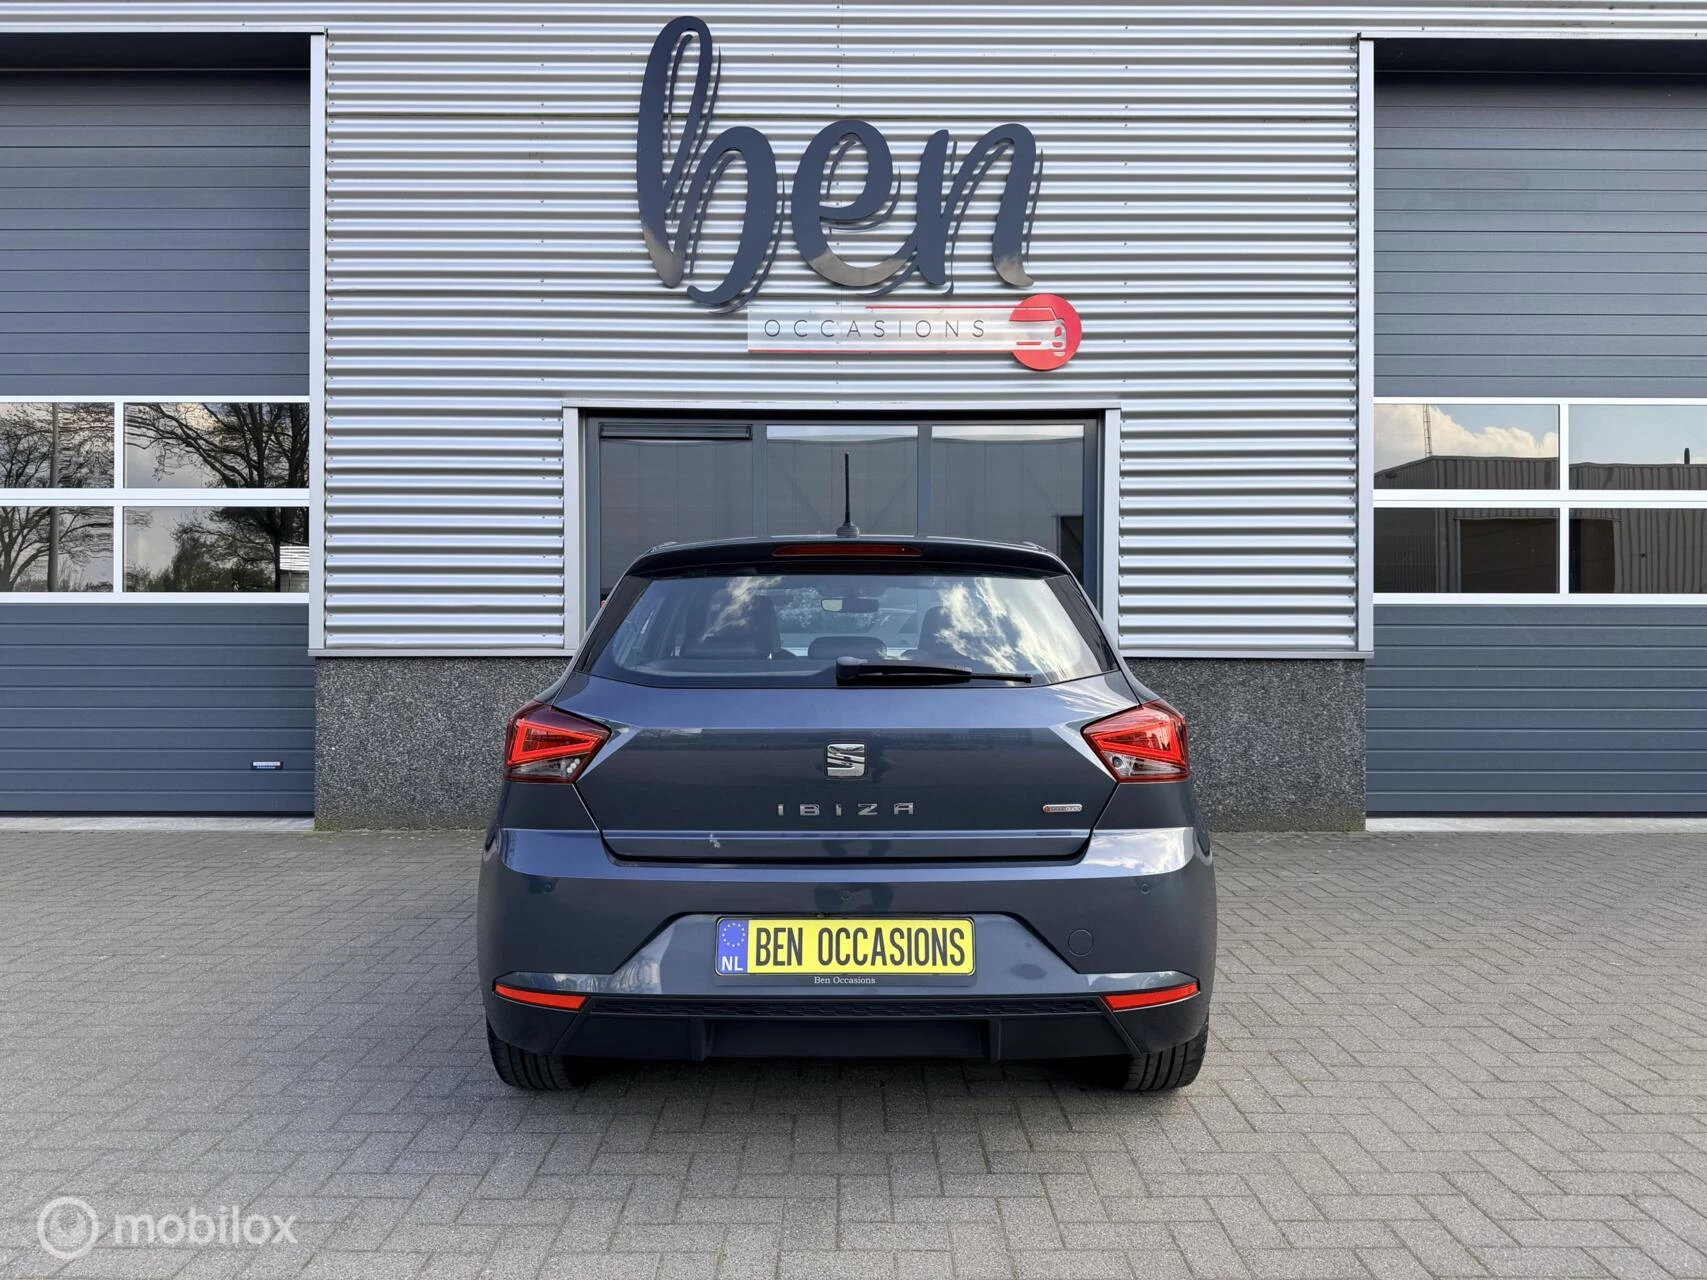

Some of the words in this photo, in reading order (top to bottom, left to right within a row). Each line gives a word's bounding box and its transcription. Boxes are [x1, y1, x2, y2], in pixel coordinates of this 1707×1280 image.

[636, 15, 1044, 314] ben
[763, 318, 986, 339] OCCASIONS
[777, 802, 914, 816] IBIZA
[755, 927, 803, 966] BEN
[818, 927, 965, 967] OCCASIONS
[721, 956, 743, 971] NL
[814, 976, 831, 985] Ben
[833, 976, 876, 985] Occasions
